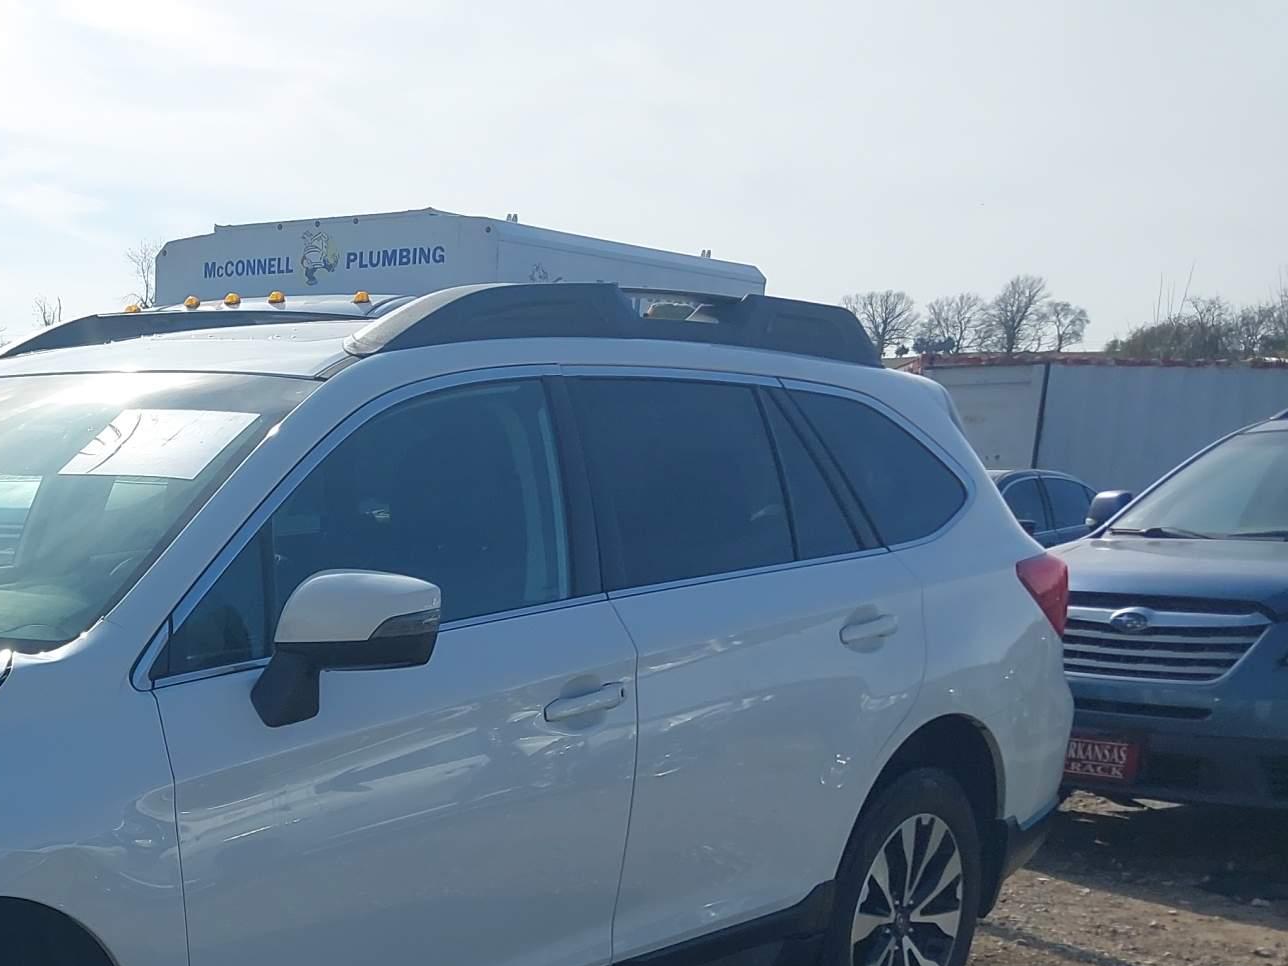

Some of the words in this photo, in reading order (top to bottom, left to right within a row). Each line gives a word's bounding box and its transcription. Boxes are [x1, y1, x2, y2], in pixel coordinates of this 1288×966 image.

[204, 257, 294, 279] McCONNELL
[346, 246, 445, 269] PLUMBING
[1066, 741, 1128, 764] RKANSAS
[1066, 761, 1124, 777] RACK
